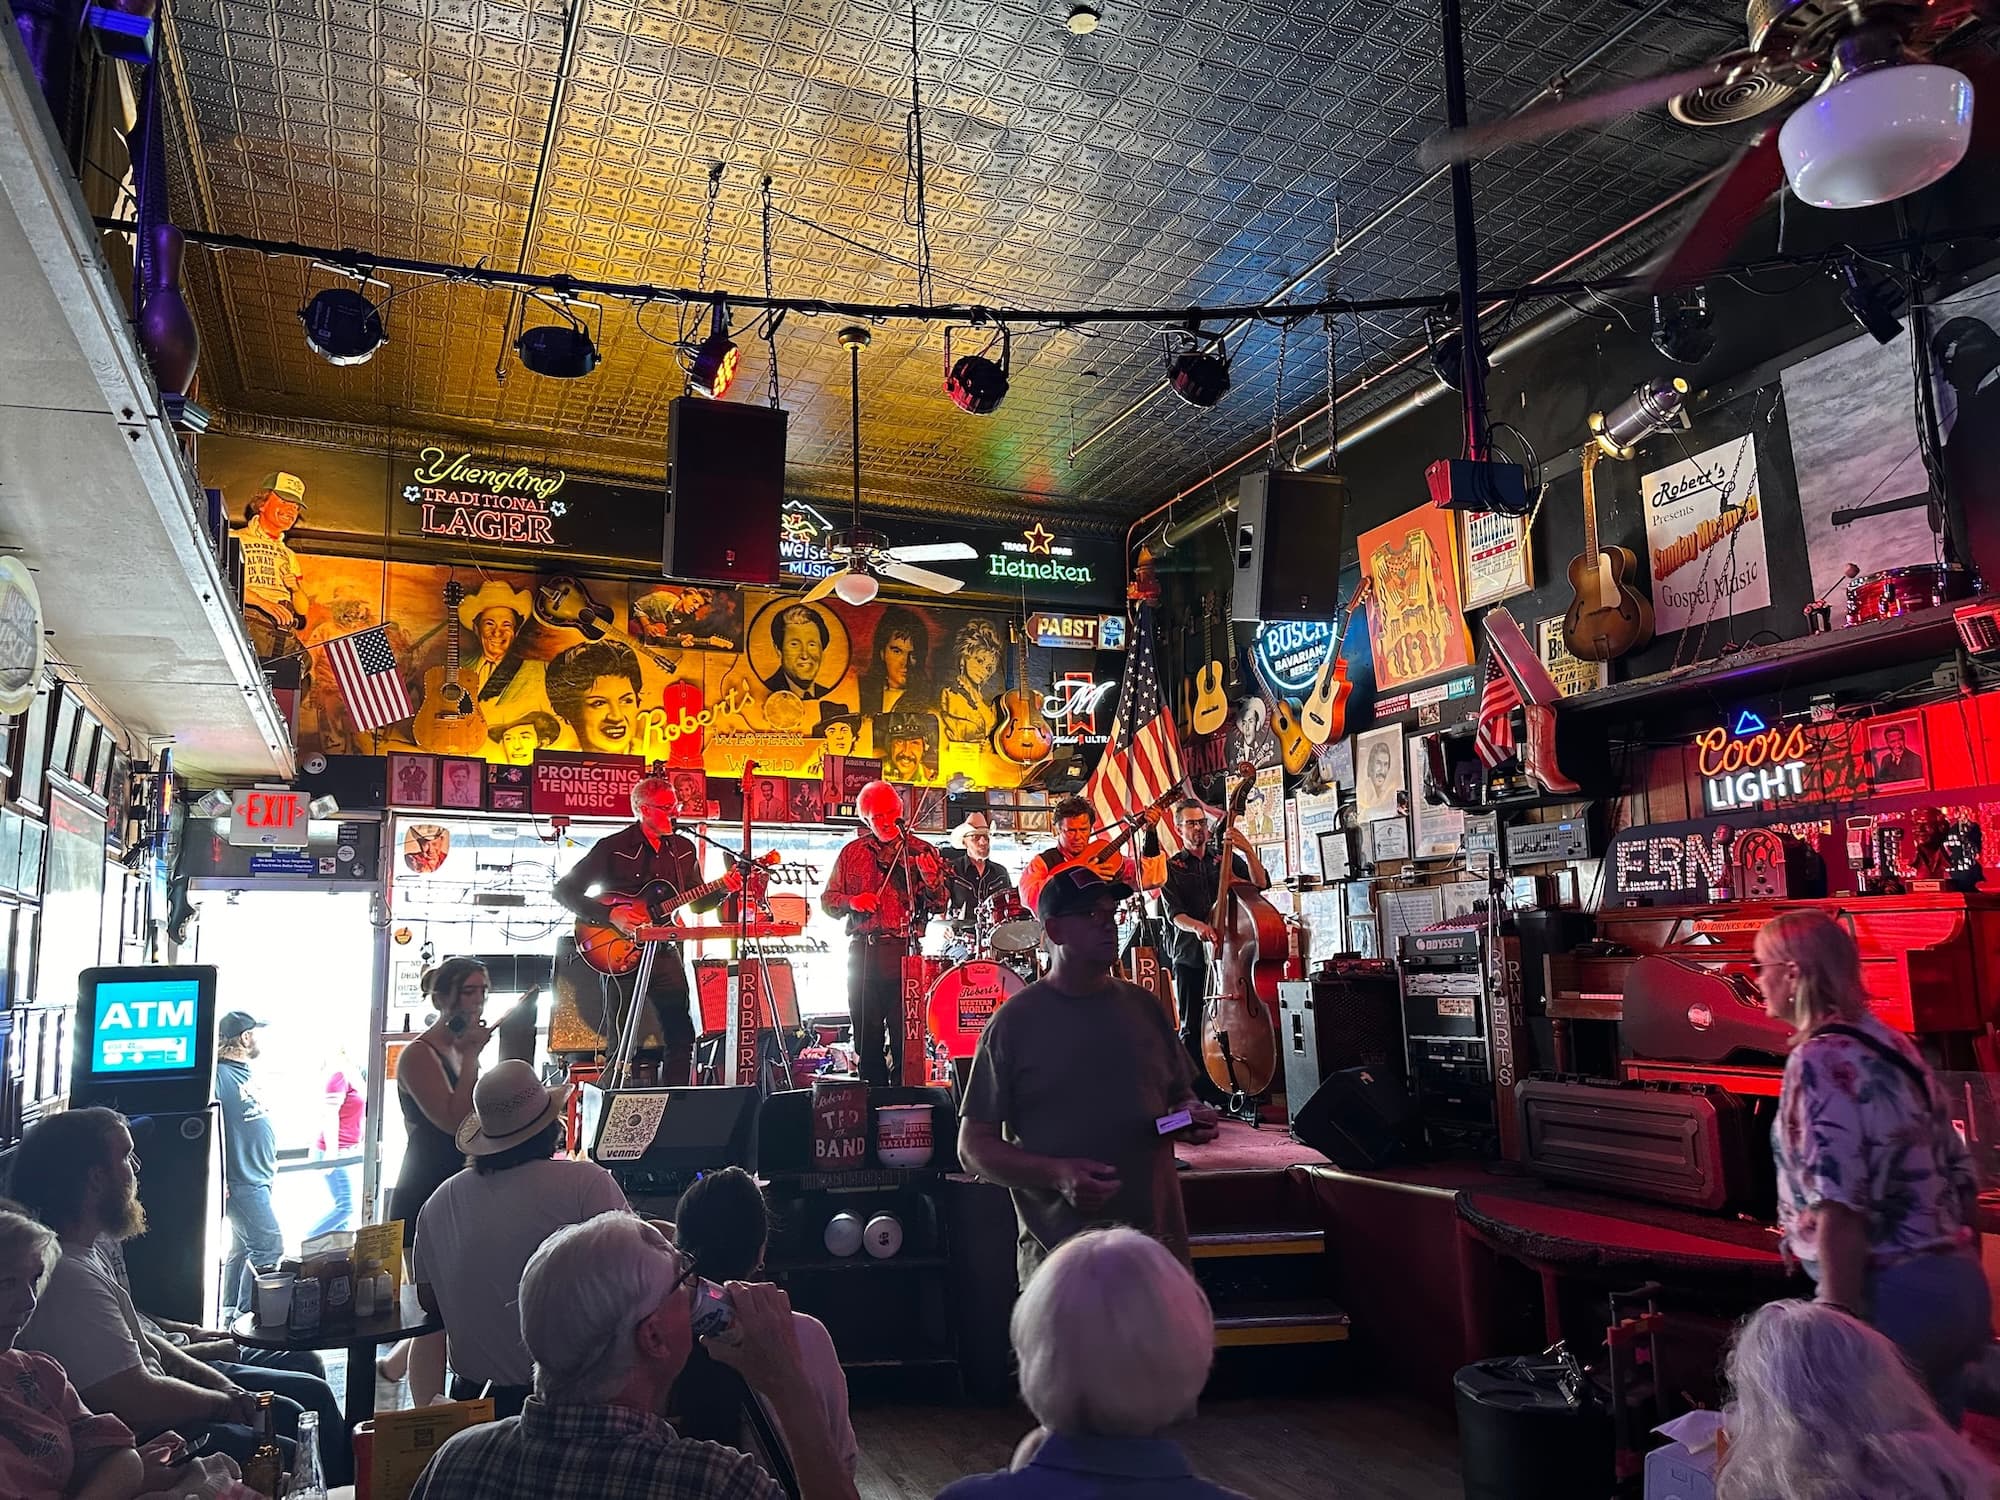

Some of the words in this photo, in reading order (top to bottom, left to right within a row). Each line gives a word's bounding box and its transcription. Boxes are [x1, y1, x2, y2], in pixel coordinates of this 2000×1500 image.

[414, 447, 565, 499] Yuengling
[1652, 462, 1726, 508] Robert's
[422, 487, 549, 513] TRADITIONAL
[421, 504, 554, 544] LAGER
[1652, 505, 1695, 527] Presents
[1653, 530, 1699, 581] Sunday
[248, 566, 257, 574] IN
[990, 554, 1092, 582] Heineken
[249, 576, 276, 586] TASTE
[1662, 582, 1711, 608] Gospel
[1714, 560, 1758, 602] Music
[1037, 617, 1098, 639] PABST
[1266, 621, 1330, 657] BUSCH
[1274, 644, 1324, 672] BAVARIAN
[1290, 663, 1312, 677] BEER
[637, 679, 755, 744] Robert's
[713, 730, 805, 747] WESTERN
[1696, 723, 1813, 776] Coors
[538, 765, 641, 782] PROTECTING
[725, 754, 795, 772] WRLD
[1709, 761, 1806, 807] LIGHT
[247, 793, 298, 828] EXIT
[565, 793, 615, 808] MUSIC
[1696, 922, 1707, 931] NO
[1711, 922, 1740, 931] DRINKS
[1426, 937, 1464, 950] ODYSSEY
[401, 972, 420, 980] DRIN
[99, 1000, 194, 1030] ATM
[905, 979, 921, 1040] RWW
[960, 1006, 993, 1014] WORLD
[606, 1149, 641, 1158] venmo
[815, 1137, 866, 1158] BAND
